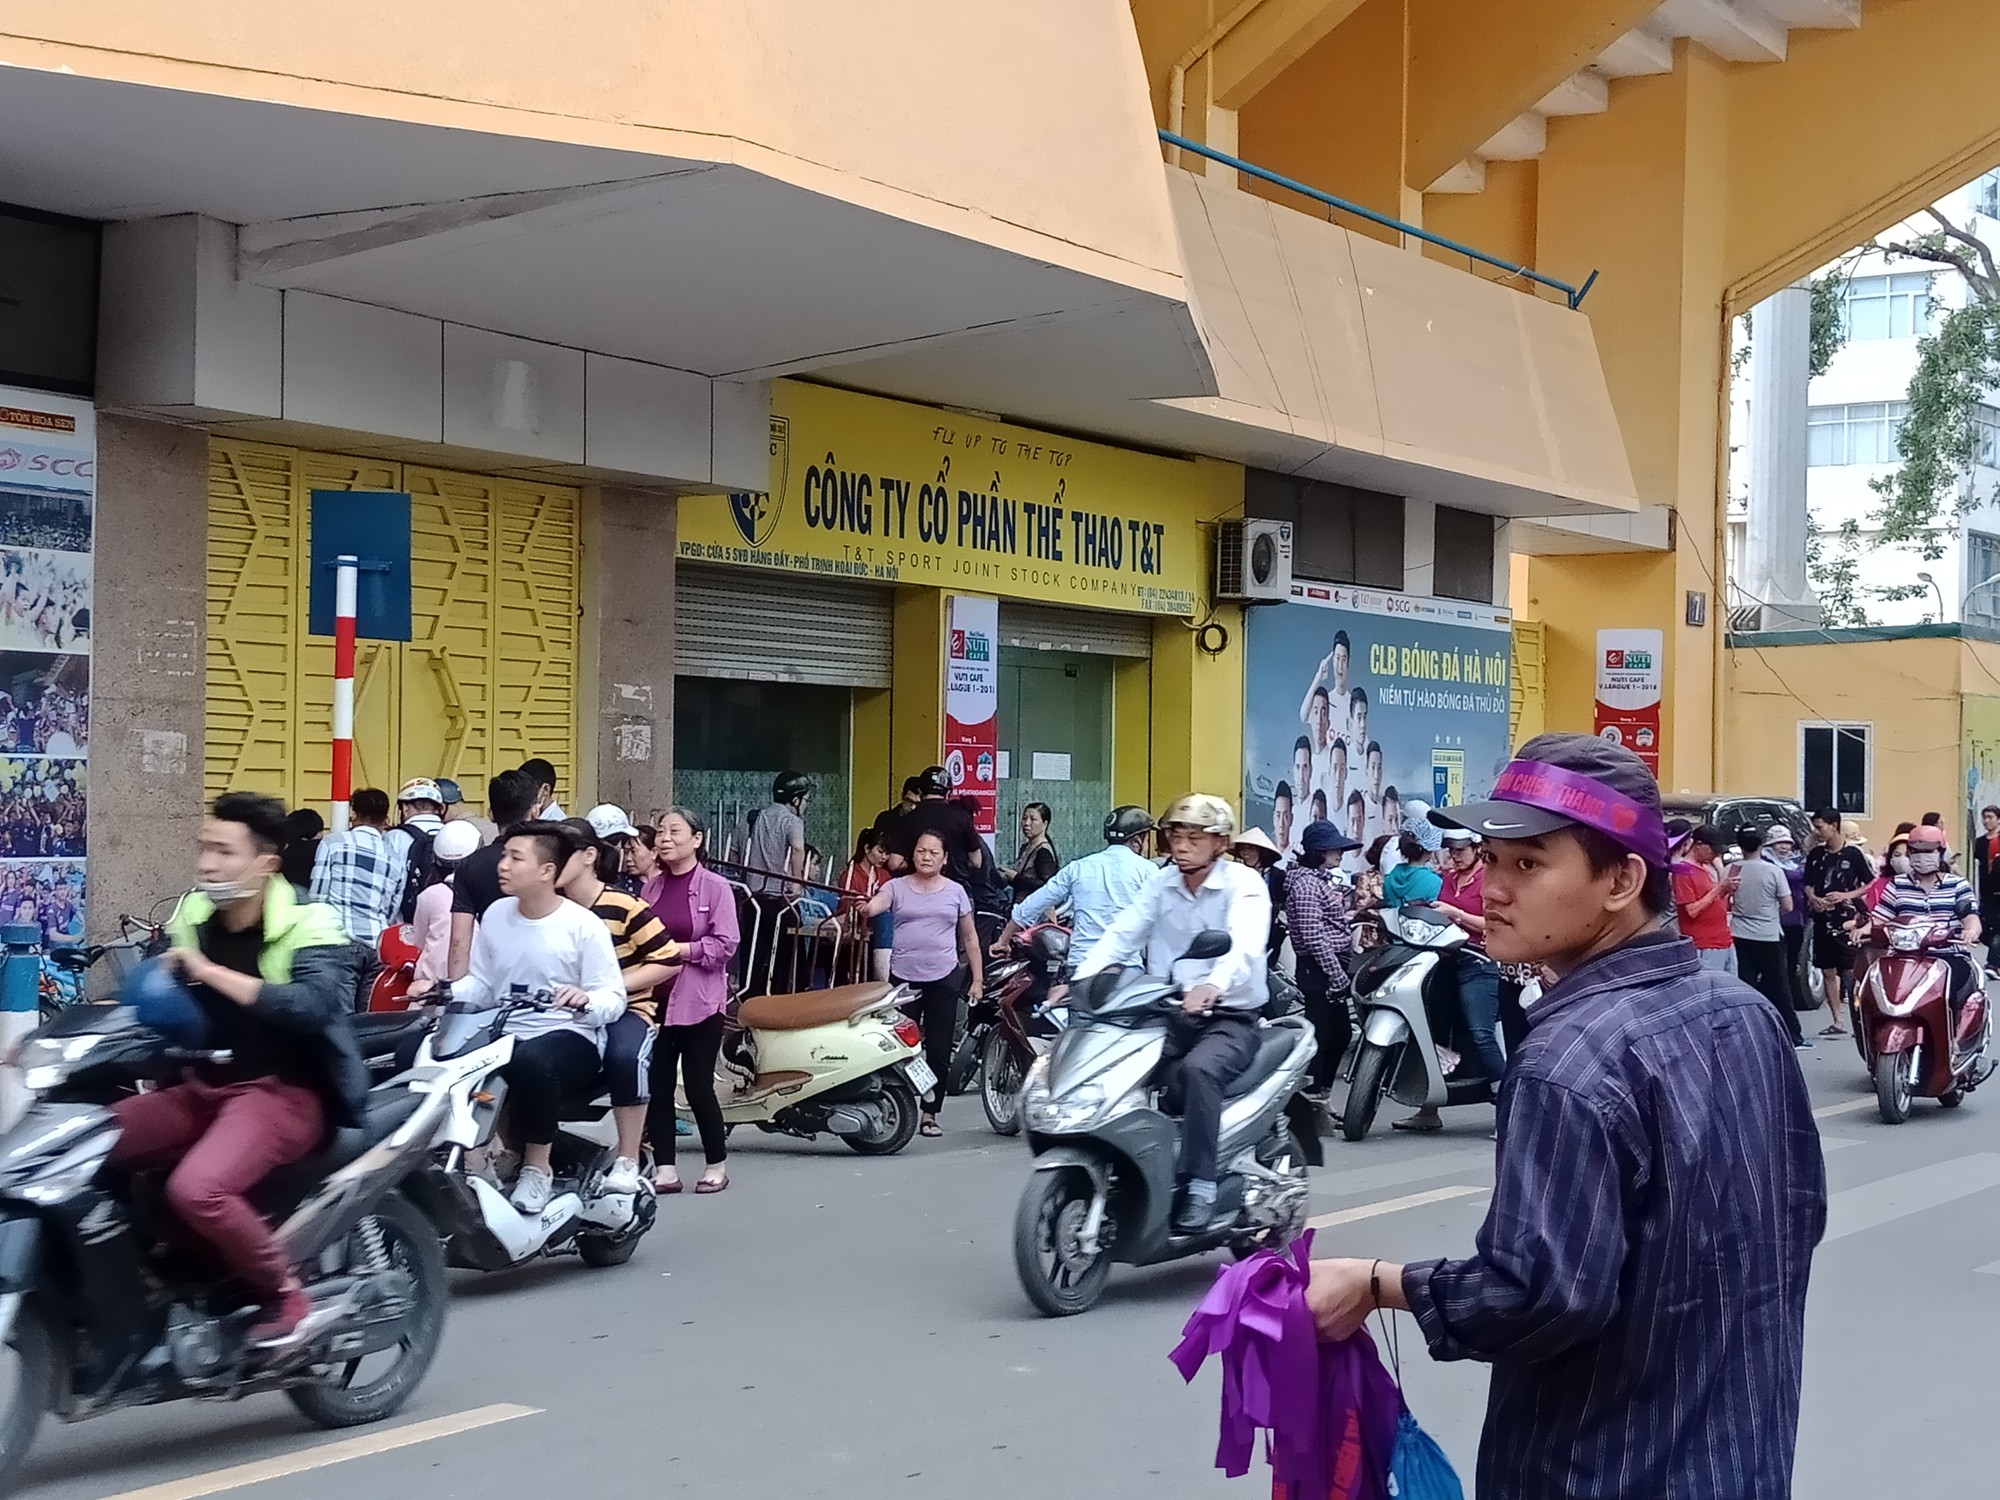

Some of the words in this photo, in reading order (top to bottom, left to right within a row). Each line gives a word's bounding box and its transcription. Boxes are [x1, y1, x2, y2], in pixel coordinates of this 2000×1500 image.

[32, 415, 53, 426] HOA
[54, 418, 74, 428] SEN
[932, 426, 956, 445] FLY
[965, 434, 981, 449] UP
[991, 437, 1008, 455] TO
[1017, 443, 1043, 460] THE
[1048, 450, 1073, 467] TOP
[804, 452, 872, 535] CÔNG
[880, 477, 911, 538] TY
[918, 455, 951, 546] CỔ
[957, 471, 1017, 555] PHẦN
[1023, 478, 1066, 562] THỂ
[1071, 511, 1123, 571] THAO
[1128, 520, 1165, 576] T&T
[725, 547, 731, 559] 5
[886, 550, 943, 571] SPORT
[953, 559, 1001, 579] JOINT
[1011, 567, 1061, 588] STOCK
[1070, 575, 1136, 597] COMPANY
[1394, 599, 1410, 613] SCG
[966, 638, 988, 651] NUTI
[1370, 643, 1397, 675] CLB
[1401, 642, 1439, 680] BÓNG
[1442, 646, 1460, 682] ĐÁ
[1464, 649, 1481, 684] HÀ
[1485, 651, 1506, 694] NỘI
[1625, 655, 1650, 663] NUTI
[1402, 688, 1416, 711] TỰ
[1417, 688, 1436, 708] HÀO
[1437, 690, 1461, 710] BÓNG
[1463, 692, 1475, 712] ĐÁ
[1475, 692, 1492, 713] THỦ
